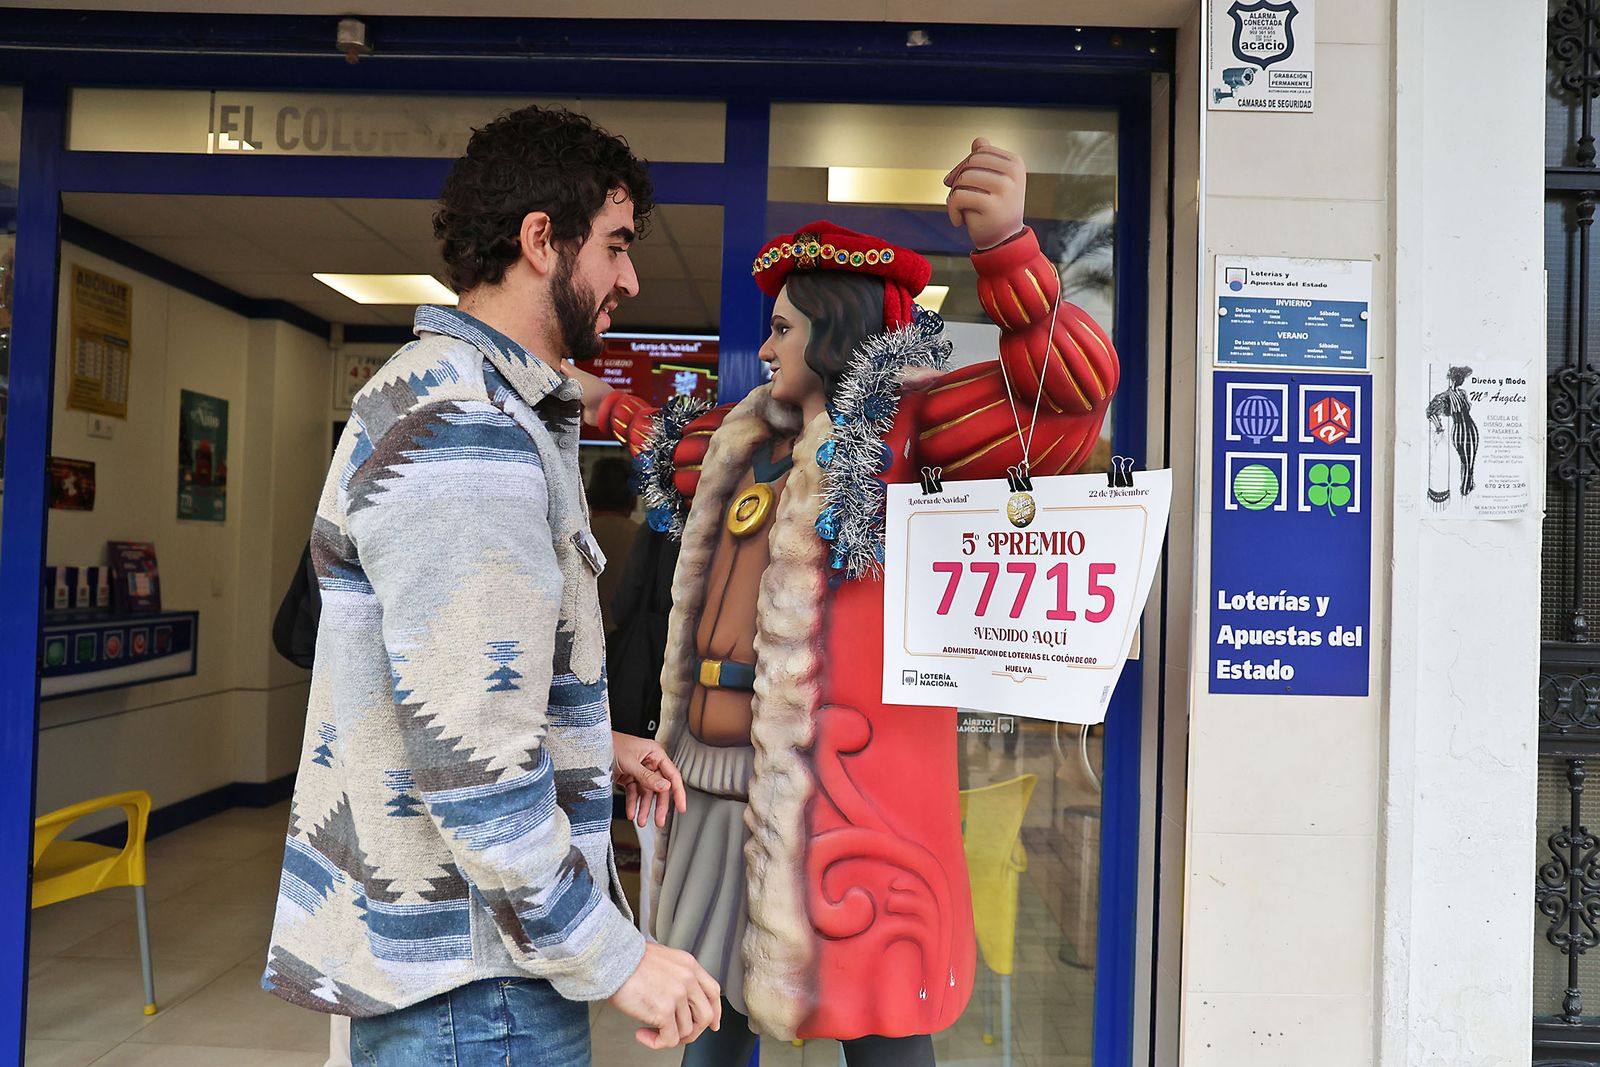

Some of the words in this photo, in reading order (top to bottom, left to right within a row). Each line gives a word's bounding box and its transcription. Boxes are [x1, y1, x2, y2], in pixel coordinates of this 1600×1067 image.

[1241, 40, 1284, 50] acacio
[1268, 100, 1276, 108] DE
[1277, 100, 1312, 109] SEGURIDAD
[218, 105, 262, 150] EL
[1276, 299, 1312, 307] INVIERNO
[1277, 331, 1308, 340] VERANO
[1472, 376, 1496, 384] Diseño
[1489, 389, 1526, 405] Ángeles
[1088, 490, 1097, 498] 22
[1108, 488, 1150, 498] Diciembre
[942, 494, 970, 503] Navidad
[988, 530, 1086, 556] PREMIO
[932, 562, 1117, 623] 77715
[1218, 590, 1310, 611] Loterías
[1316, 596, 1330, 617] y
[974, 627, 1028, 642] VENDIDO
[1032, 628, 1067, 647] AQUÍ
[1216, 625, 1322, 650] Apuestas
[1328, 626, 1363, 647] del
[998, 650, 1008, 658] DE
[1008, 651, 1041, 661] LOTERIAS
[1005, 665, 1032, 674] HUELVA
[1216, 659, 1294, 680] Estado
[920, 680, 958, 688] NACIONAL
